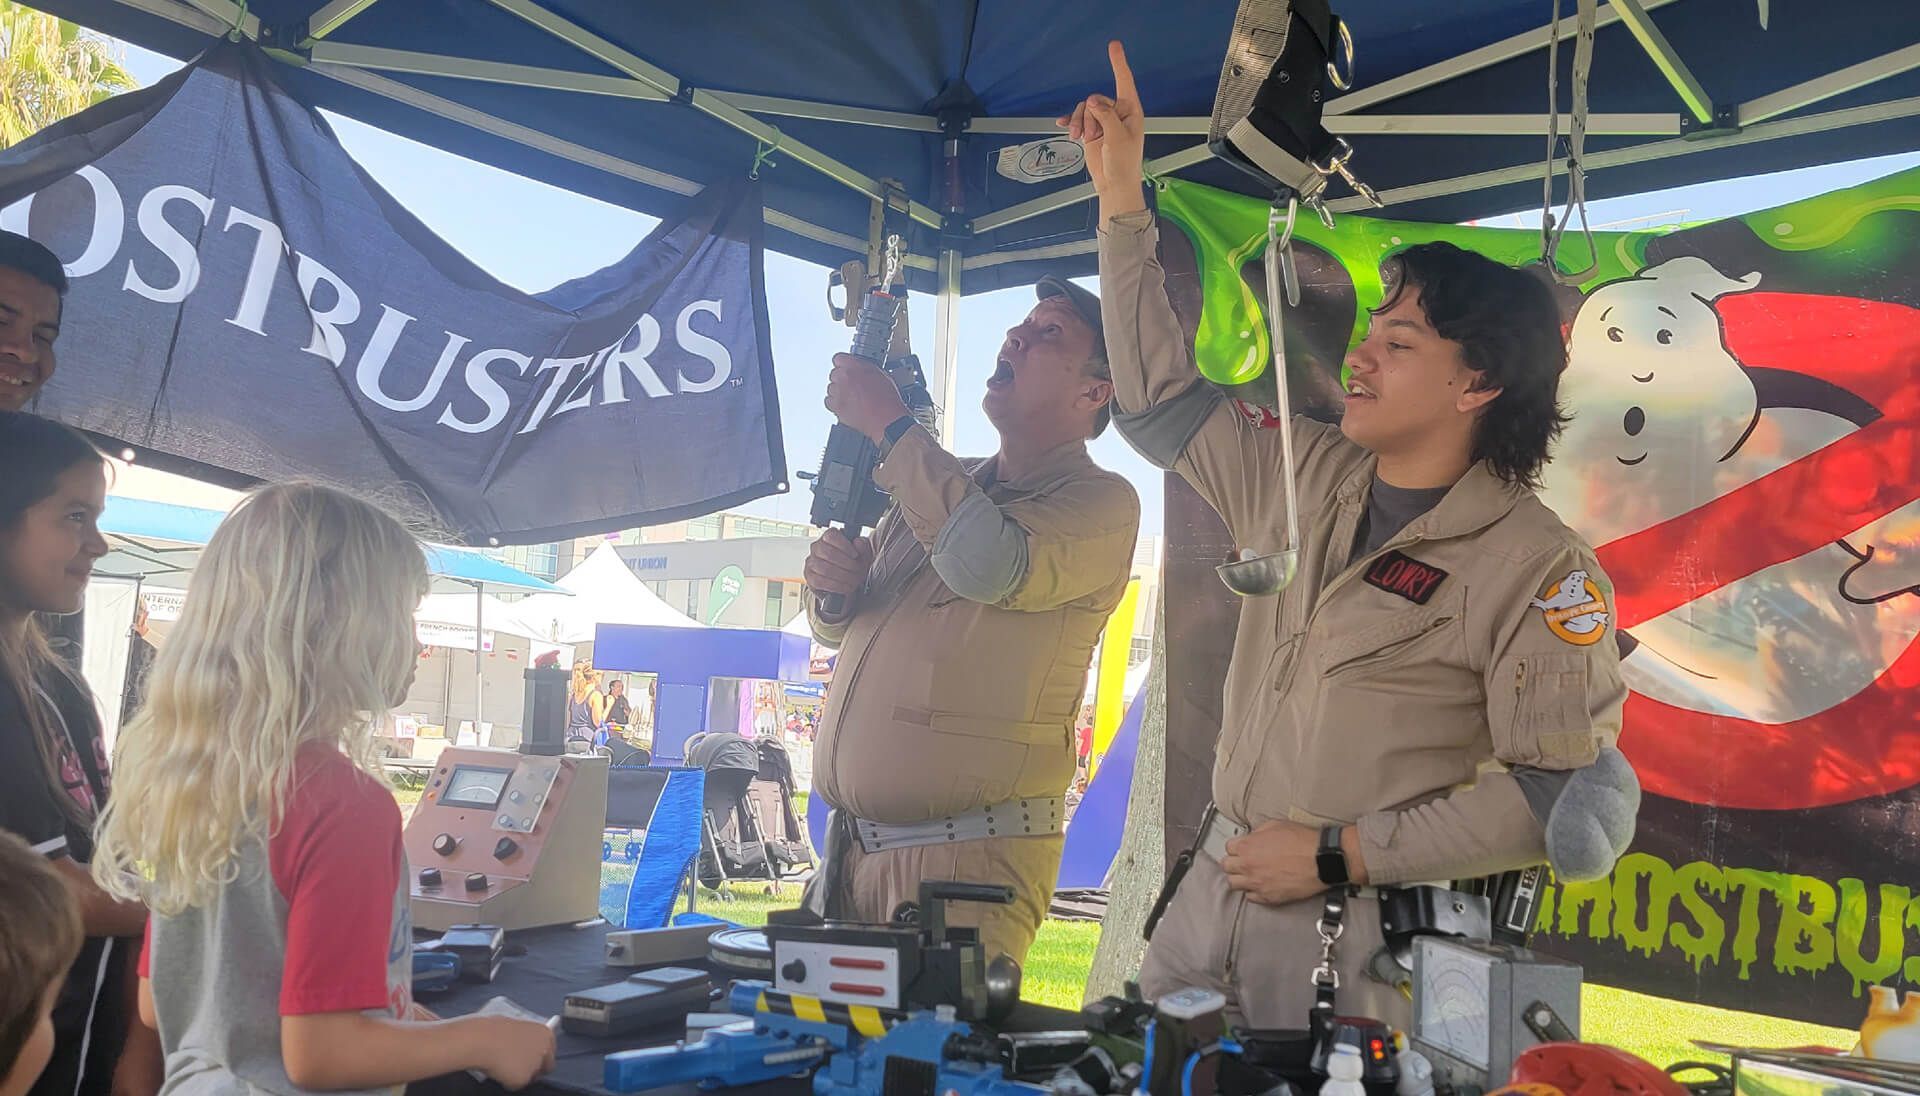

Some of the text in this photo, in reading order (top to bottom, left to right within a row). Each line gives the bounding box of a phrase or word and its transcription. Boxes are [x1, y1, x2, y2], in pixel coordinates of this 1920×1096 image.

[638, 556, 667, 570] UNION
[1369, 555, 1441, 599] LOWRY
[1533, 852, 1920, 998] HOSTBU
